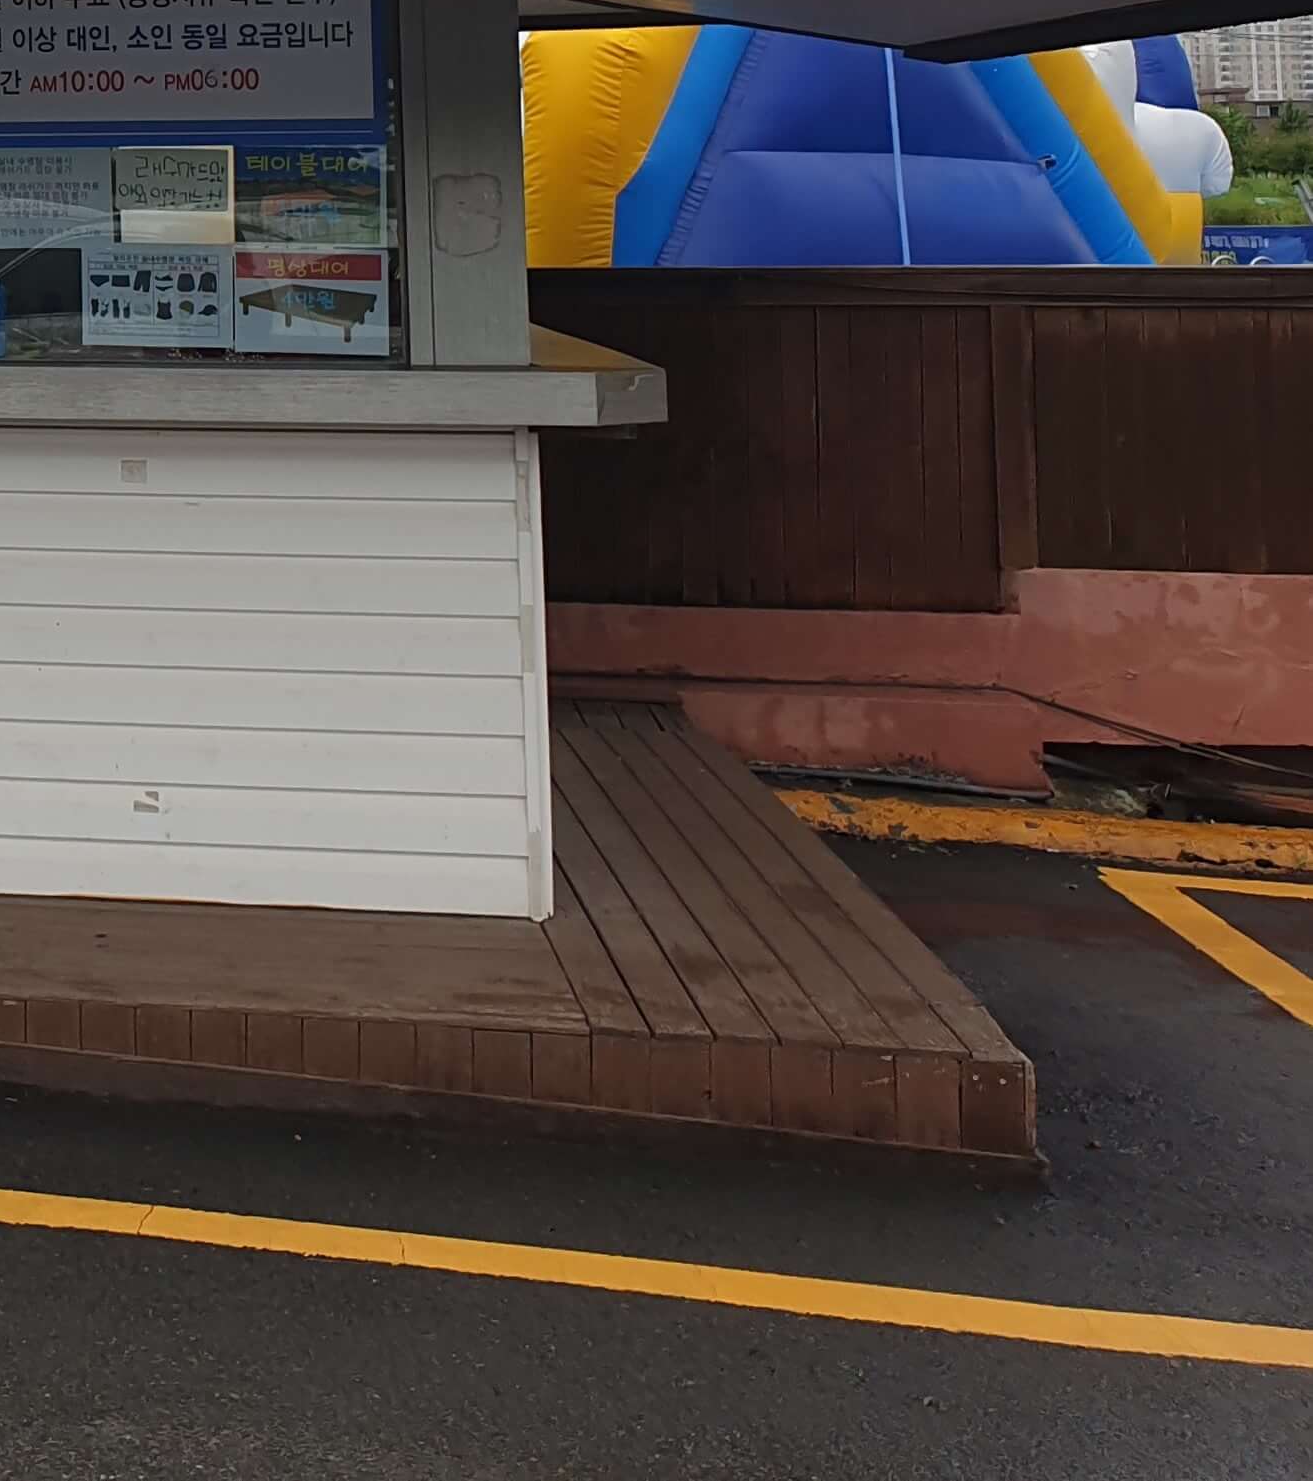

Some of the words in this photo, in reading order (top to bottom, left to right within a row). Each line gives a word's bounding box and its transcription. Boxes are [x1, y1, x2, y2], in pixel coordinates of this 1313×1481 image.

[12, 25, 57, 52] 이상
[67, 25, 118, 53] 대인,
[127, 24, 173, 50] 소인
[181, 23, 228, 50] 동일
[237, 21, 353, 49] 요금입니다
[29, 68, 125, 94] AM10:00
